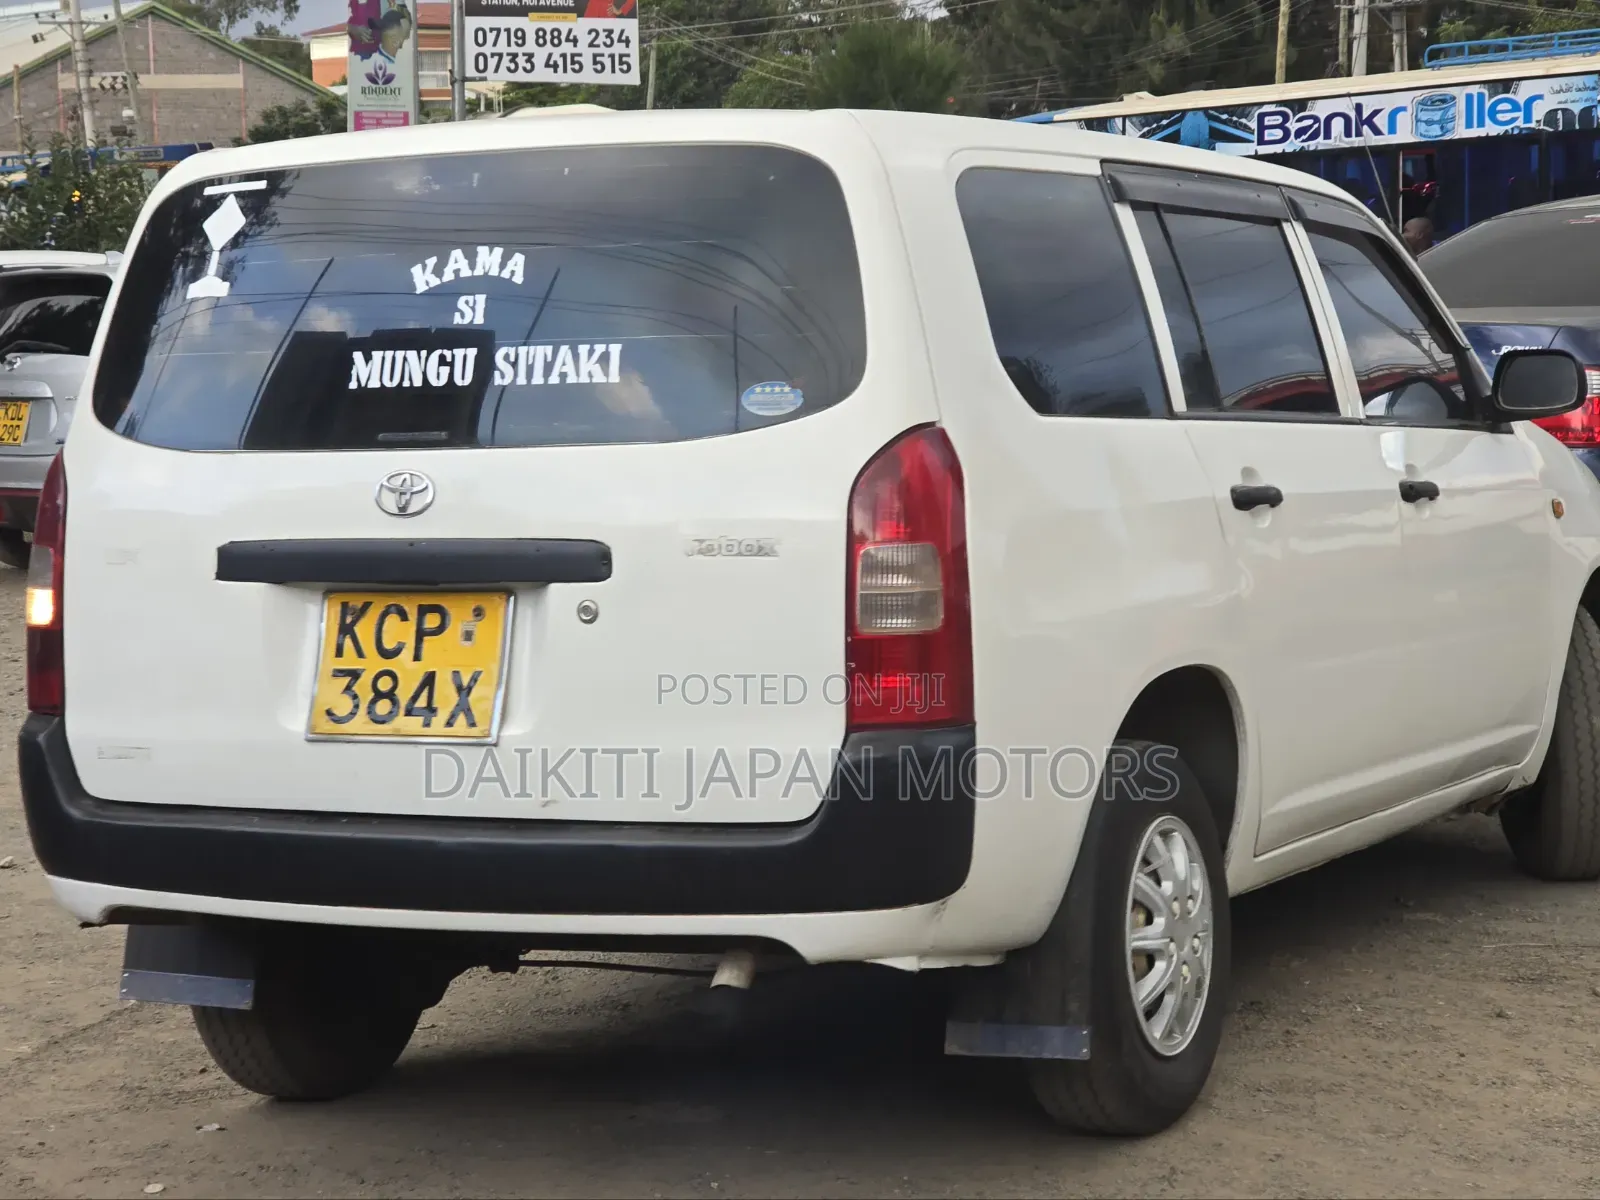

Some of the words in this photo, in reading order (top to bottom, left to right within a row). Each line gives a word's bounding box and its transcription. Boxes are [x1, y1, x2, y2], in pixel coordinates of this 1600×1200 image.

[473, 27, 527, 48] 0719
[534, 27, 579, 48] 884
[587, 28, 631, 49] 234
[474, 52, 535, 75] 0733
[544, 53, 584, 74] 415
[592, 53, 632, 75] 515
[410, 246, 526, 294] KAMA
[453, 294, 487, 325] SI
[348, 347, 478, 390] MUNGU
[494, 344, 623, 386] SITAKI
[0, 424, 20, 442] 29C
[334, 601, 452, 662] KCP
[324, 668, 484, 728] 384X
